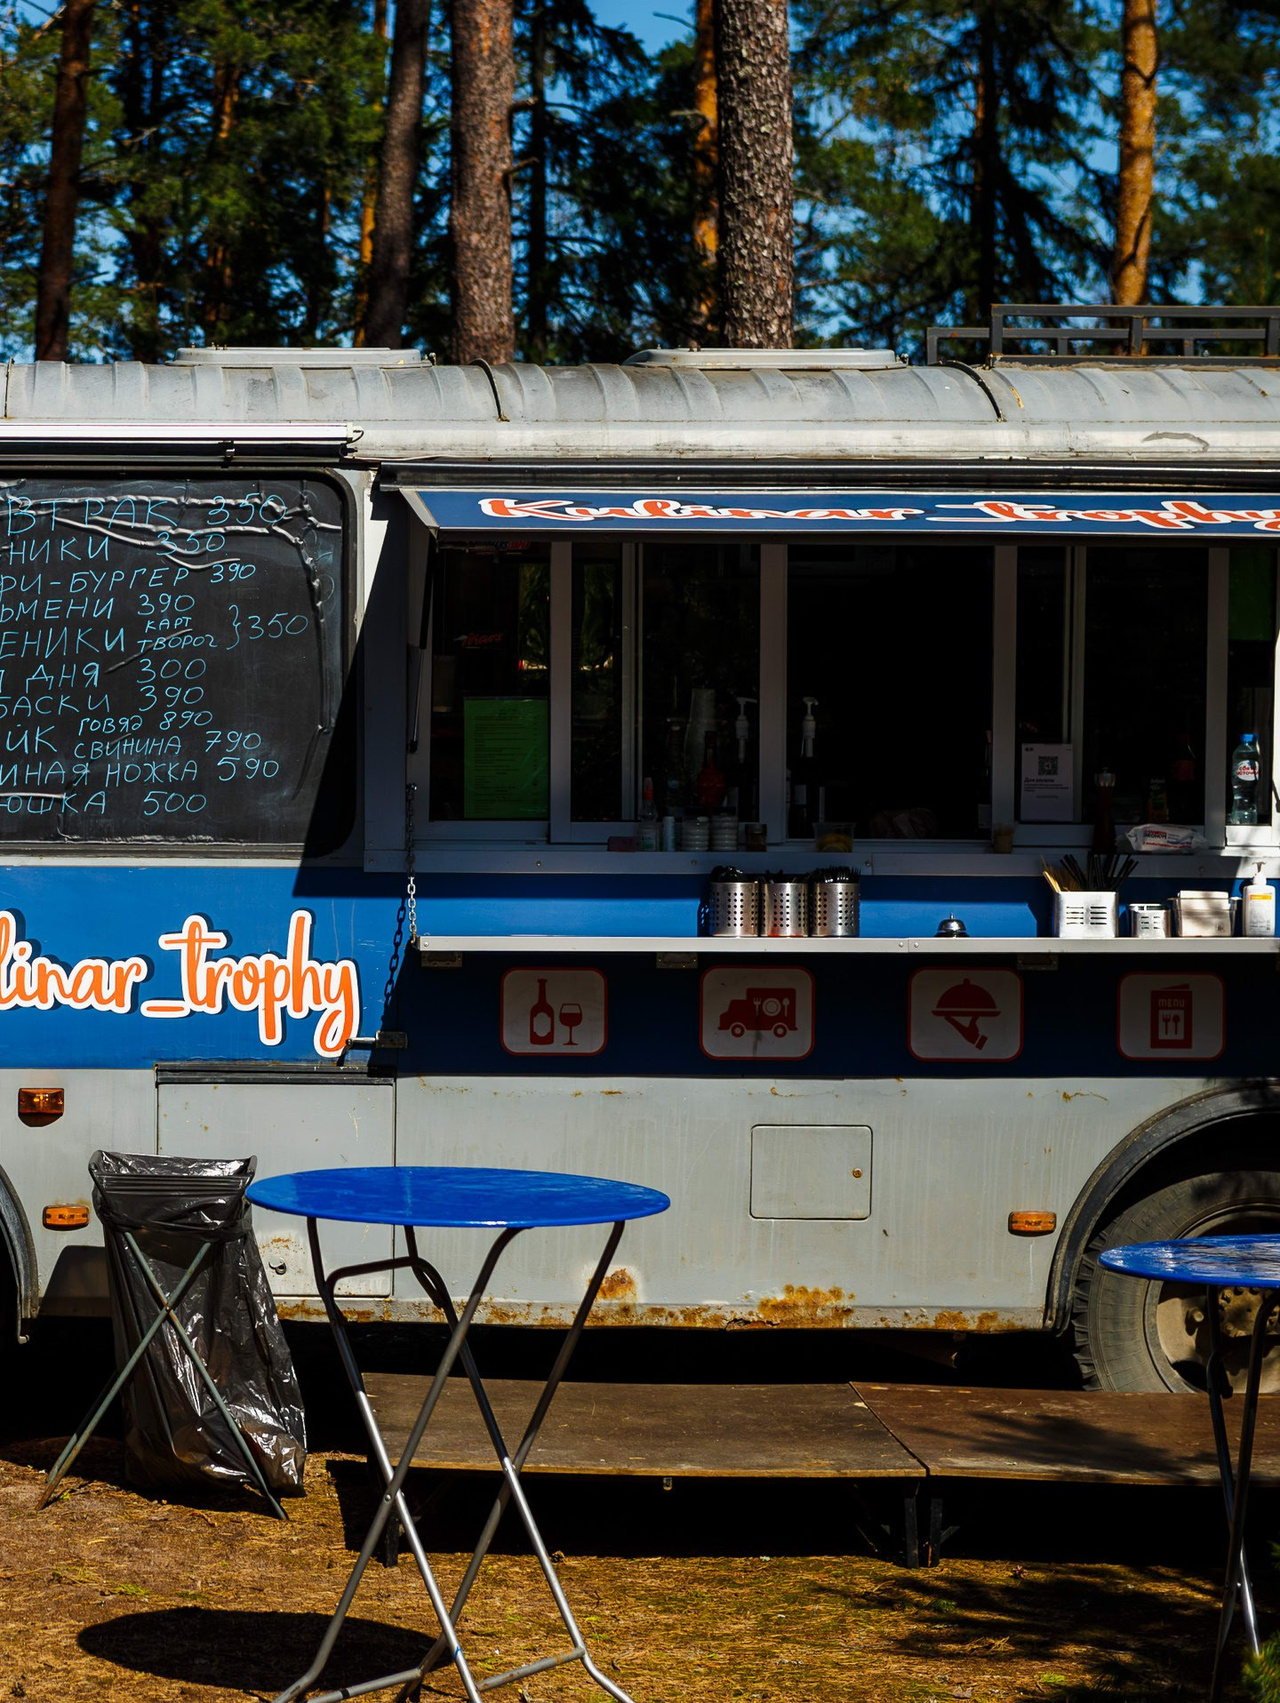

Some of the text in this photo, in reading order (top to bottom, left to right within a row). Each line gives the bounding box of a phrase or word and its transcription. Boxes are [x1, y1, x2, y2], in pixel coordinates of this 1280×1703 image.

[207, 494, 287, 525] 350
[156, 531, 227, 556] 350
[210, 563, 256, 583] 390
[138, 593, 195, 615] 390
[145, 616, 192, 632] КАРТ
[26, 662, 99, 694] ДНЯ
[137, 659, 207, 684] 300
[138, 685, 205, 712] 390
[159, 709, 213, 731] 890
[74, 738, 182, 760] СВИНИНА
[206, 730, 262, 752] 790
[105, 760, 198, 786] НОЖКА
[217, 756, 280, 781] 590
[143, 791, 207, 816] 500
